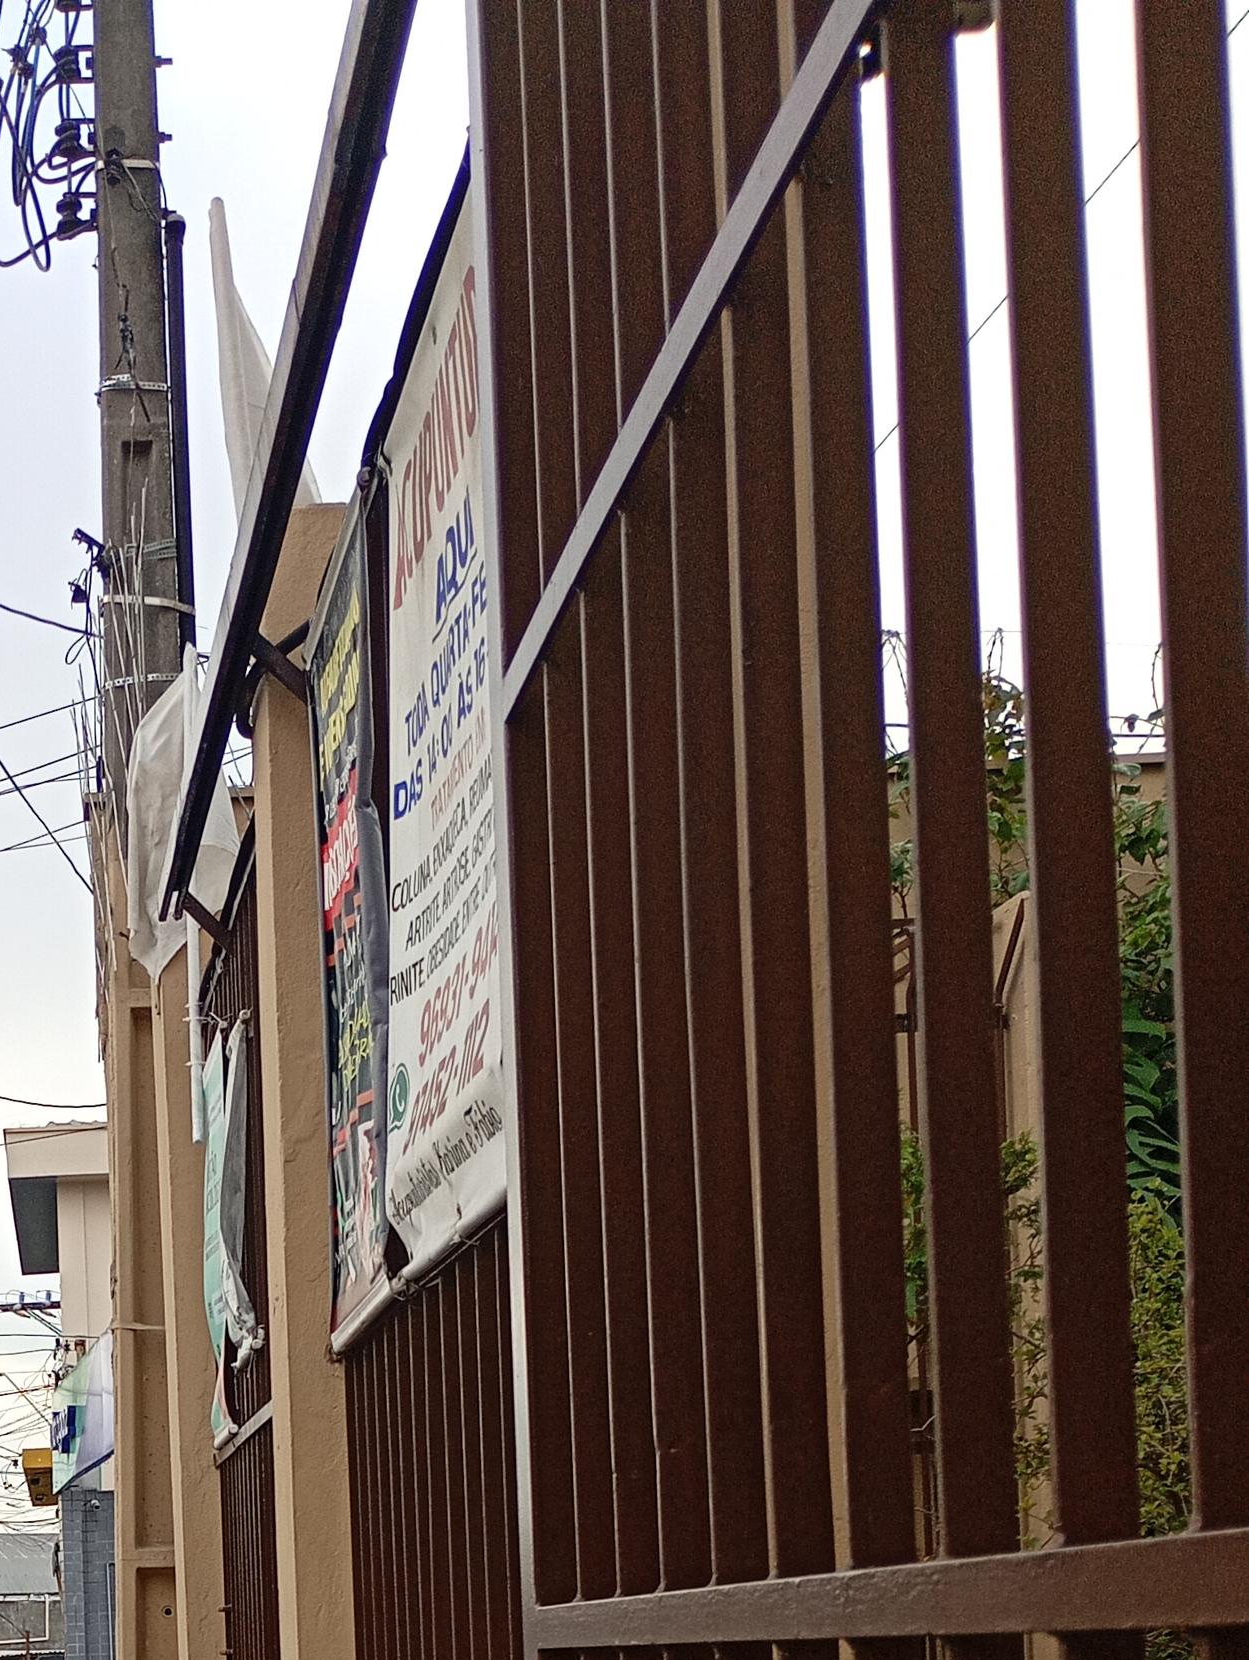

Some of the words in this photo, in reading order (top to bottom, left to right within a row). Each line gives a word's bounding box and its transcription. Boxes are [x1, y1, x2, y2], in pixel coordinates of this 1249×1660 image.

[436, 486, 474, 625] AQUI
[394, 758, 423, 820] DAS
[457, 673, 474, 729] ÀS
[474, 636, 489, 692] 16
[405, 681, 430, 755] TODA
[469, 754, 493, 820] REUMA
